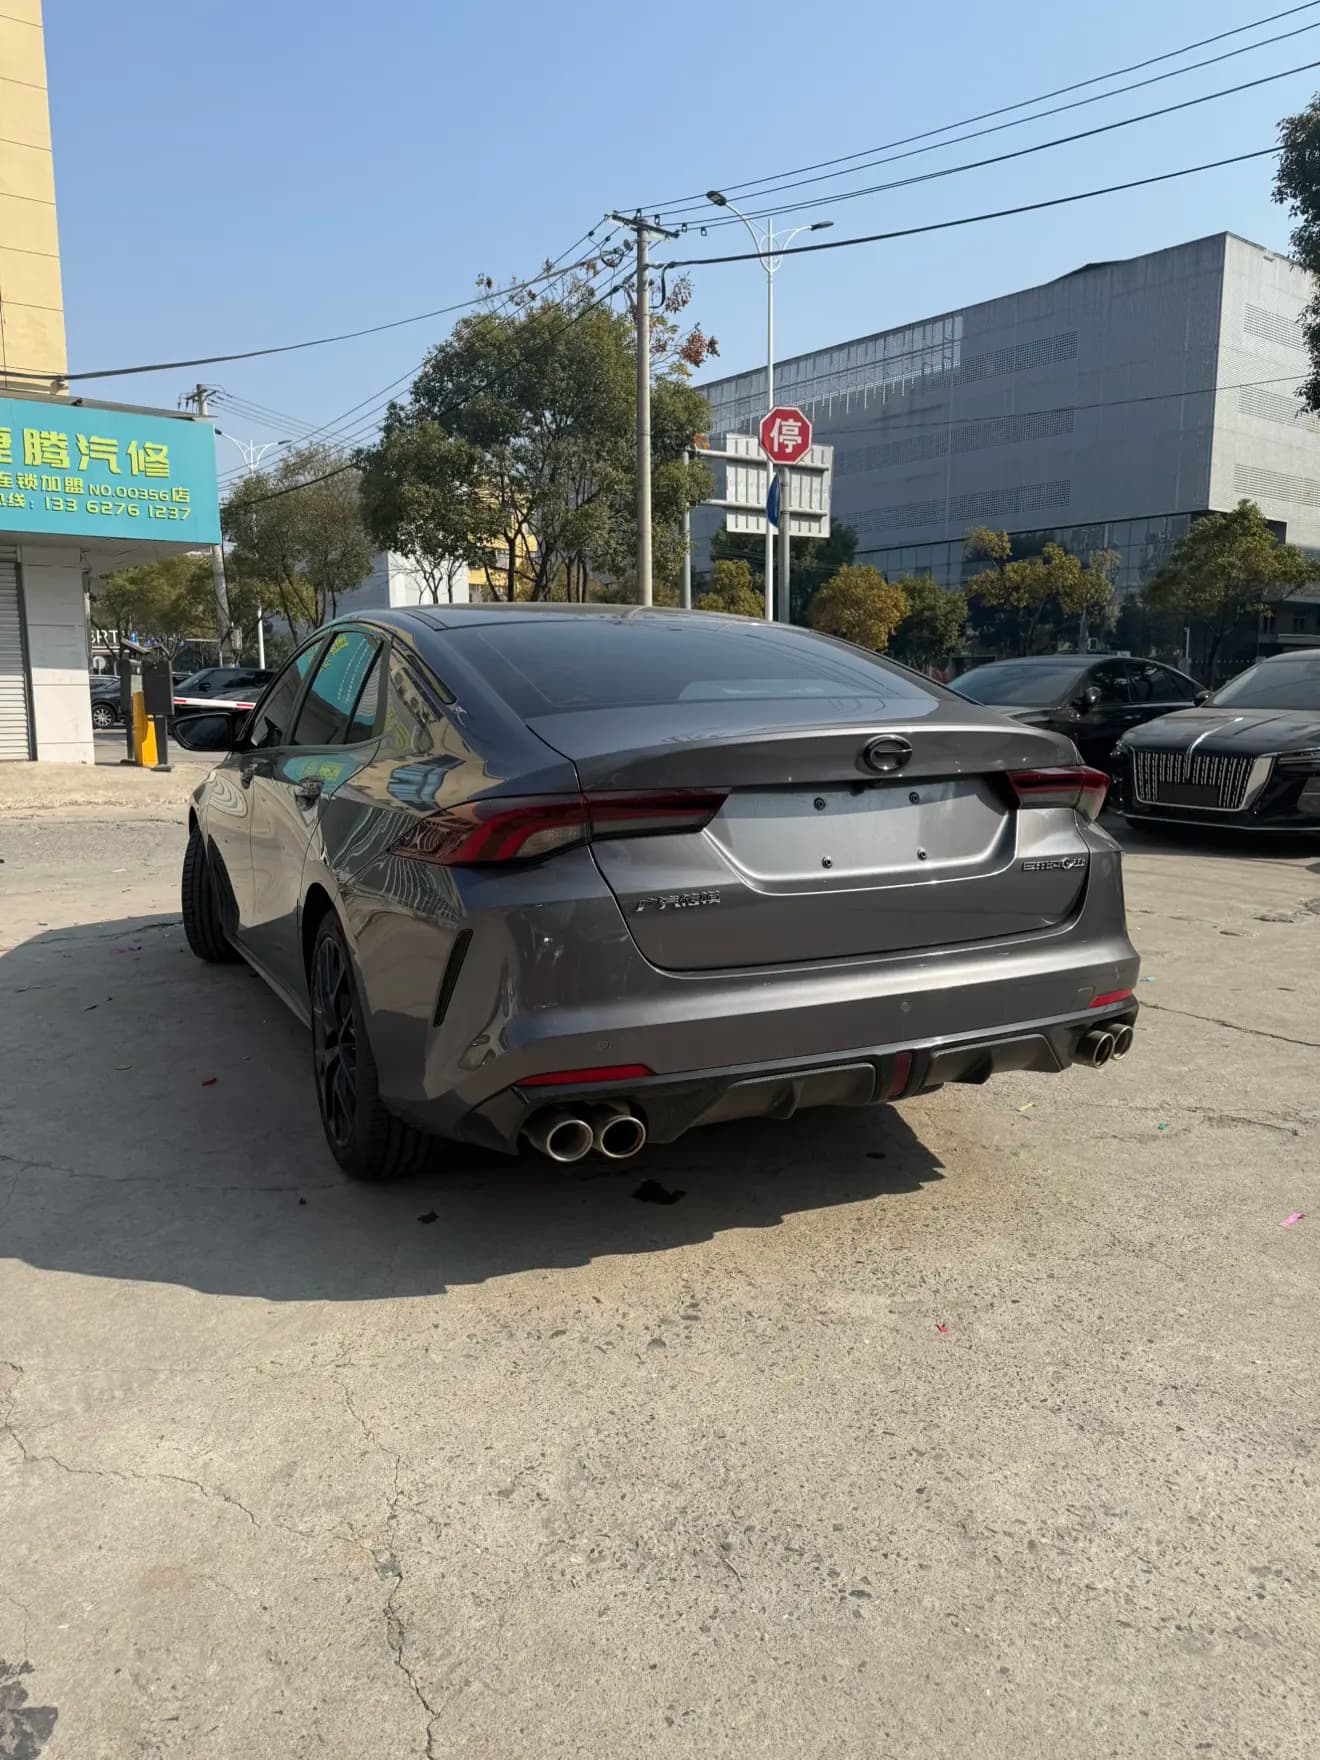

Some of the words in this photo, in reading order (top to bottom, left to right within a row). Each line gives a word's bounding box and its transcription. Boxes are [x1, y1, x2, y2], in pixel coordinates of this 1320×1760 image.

[0, 426, 170, 478] 腾汽修
[769, 417, 802, 453] 停
[45, 495, 78, 512] 133
[86, 500, 141, 517] 6276
[148, 504, 191, 520] 1237
